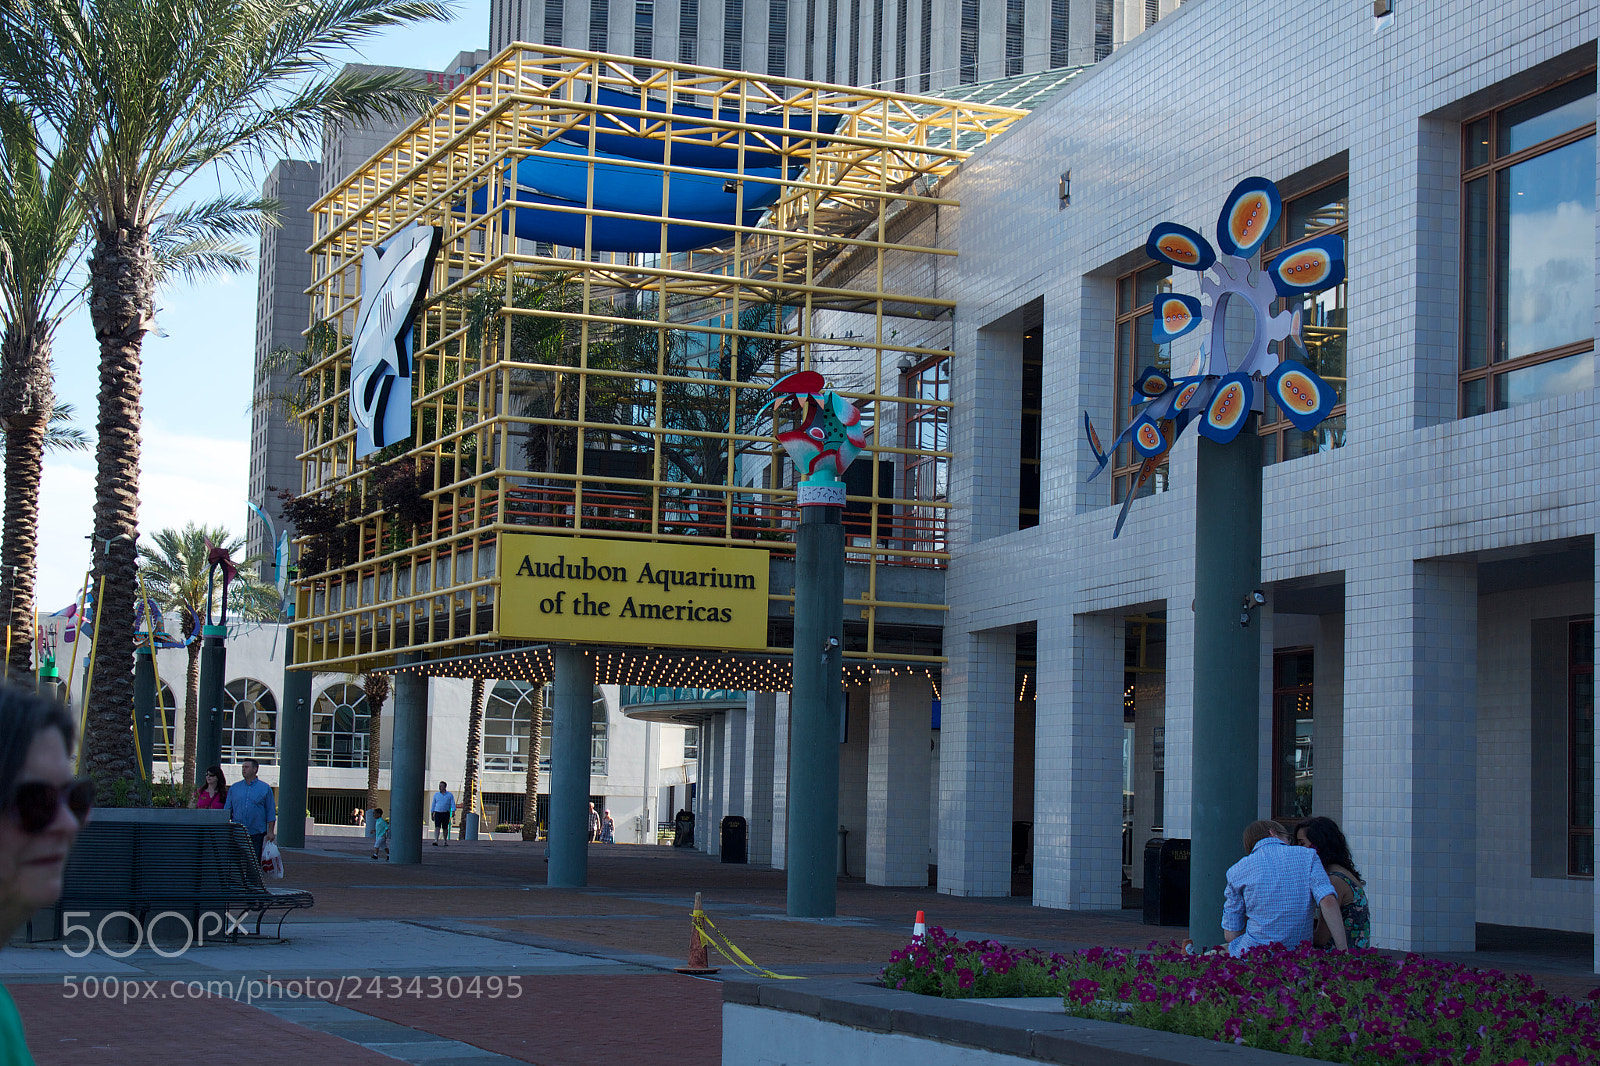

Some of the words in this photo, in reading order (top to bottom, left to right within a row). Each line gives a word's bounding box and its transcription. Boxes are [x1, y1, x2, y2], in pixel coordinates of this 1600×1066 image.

[515, 554, 628, 583] Audubon
[636, 562, 757, 592] Aquarium
[539, 590, 567, 615] of
[572, 592, 611, 617] the
[618, 596, 733, 623] Americas
